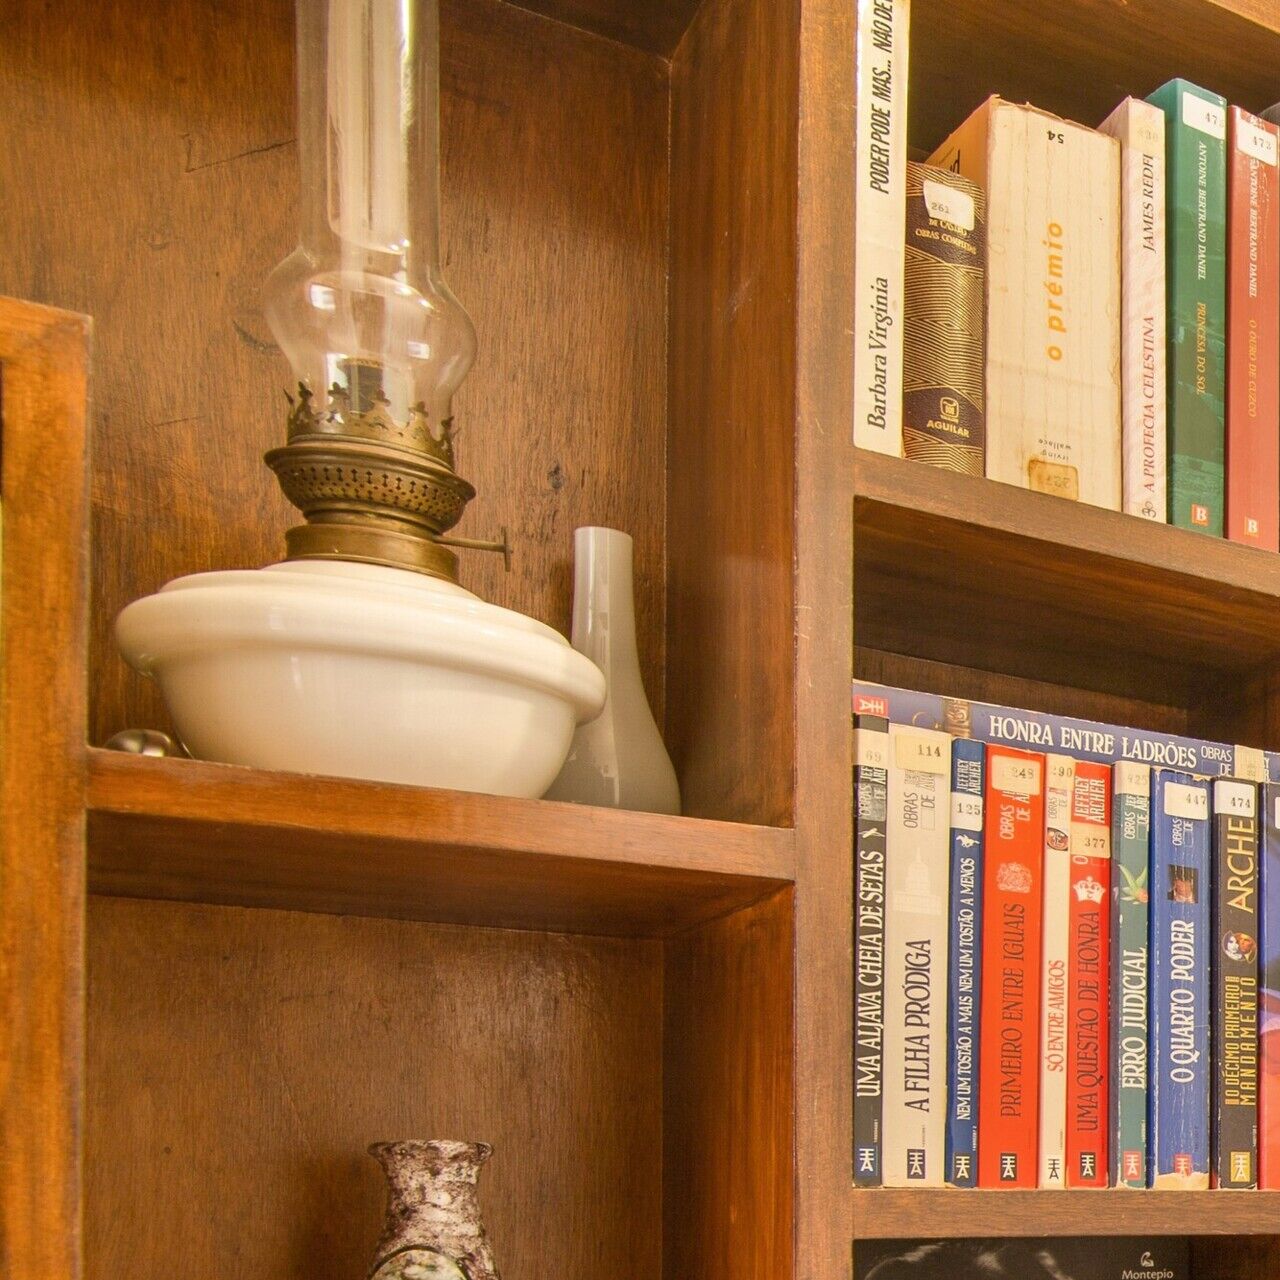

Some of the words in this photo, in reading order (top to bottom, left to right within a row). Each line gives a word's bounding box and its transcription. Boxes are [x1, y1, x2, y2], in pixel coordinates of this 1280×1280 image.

[873, 17, 892, 53] NÃO
[872, 60, 892, 104] MAS...
[871, 107, 891, 146] PODE
[870, 143, 890, 195] PODER
[1198, 140, 1207, 187] ANTOINE
[1142, 202, 1156, 253] JAMES
[1198, 188, 1207, 243] BERTRAND
[1249, 208, 1257, 262] BERTRAND
[1043, 222, 1067, 335] prémio
[1197, 244, 1207, 281] DANIEL
[1249, 263, 1257, 298] DANIEL
[1197, 302, 1207, 354] PRINCESA
[1143, 316, 1155, 400] CELESTINA
[1197, 355, 1207, 373] DO
[867, 354, 887, 430] Barbara
[1196, 375, 1206, 395] SOL
[1248, 382, 1257, 418] CUZCO
[927, 420, 970, 438] AGUILAR
[1143, 404, 1155, 474] PROFECIA
[917, 744, 942, 757] 114
[990, 715, 1054, 747] HONRA
[1060, 726, 1115, 755] ENTRE
[1122, 735, 1197, 770] LADRÕES
[1201, 745, 1232, 763] OBRAS
[956, 759, 968, 790] JEFFREY
[966, 761, 981, 795] ARCHER
[904, 792, 918, 829] OBRAS
[1073, 776, 1090, 819] JEFFREY
[1087, 778, 1105, 824] ARCHER
[1000, 803, 1015, 840] OBRAS
[1124, 811, 1136, 840] OBRAS
[860, 850, 885, 903] SETAS
[960, 857, 975, 895] MENOS
[860, 905, 884, 929] DE
[959, 908, 974, 947] TOSTÃO
[1003, 902, 1025, 961] IGUAIS
[858, 932, 883, 987] CHEIA
[958, 947, 973, 968] UM
[1077, 911, 1101, 976] HONRA
[1170, 918, 1195, 983] PODER
[901, 939, 931, 1032] PRÓDIGA
[958, 967, 973, 993] NEM
[1002, 968, 1024, 1024] ENTRE
[1047, 959, 1065, 1011] AMIGOS
[1078, 980, 1099, 1001] DE
[1123, 946, 1147, 1031] JUDICIAL
[857, 990, 883, 1050] ALJAVA
[957, 996, 973, 1024] MAIS
[1047, 1012, 1064, 1052] ENTRE
[1170, 987, 1200, 1062] QUARTO
[957, 1037, 972, 1075] TOSTÃO
[1046, 1053, 1064, 1072] SÓ
[1076, 1007, 1104, 1086] QUESTÃO
[1121, 1036, 1146, 1090] ERRO
[1240, 976, 1256, 1106] MANDAMENTO
[857, 1054, 882, 1098] UMA
[905, 1034, 930, 1093] FILHA
[957, 1076, 972, 1095] UM
[1000, 1028, 1022, 1117] PRIMEIRO
[1222, 1042, 1240, 1086] DÉCIMO
[905, 1097, 930, 1113] A
[957, 1096, 971, 1121] NEM
[1077, 1085, 1098, 1132] UMA
[1122, 1268, 1173, 1280] Montepio
